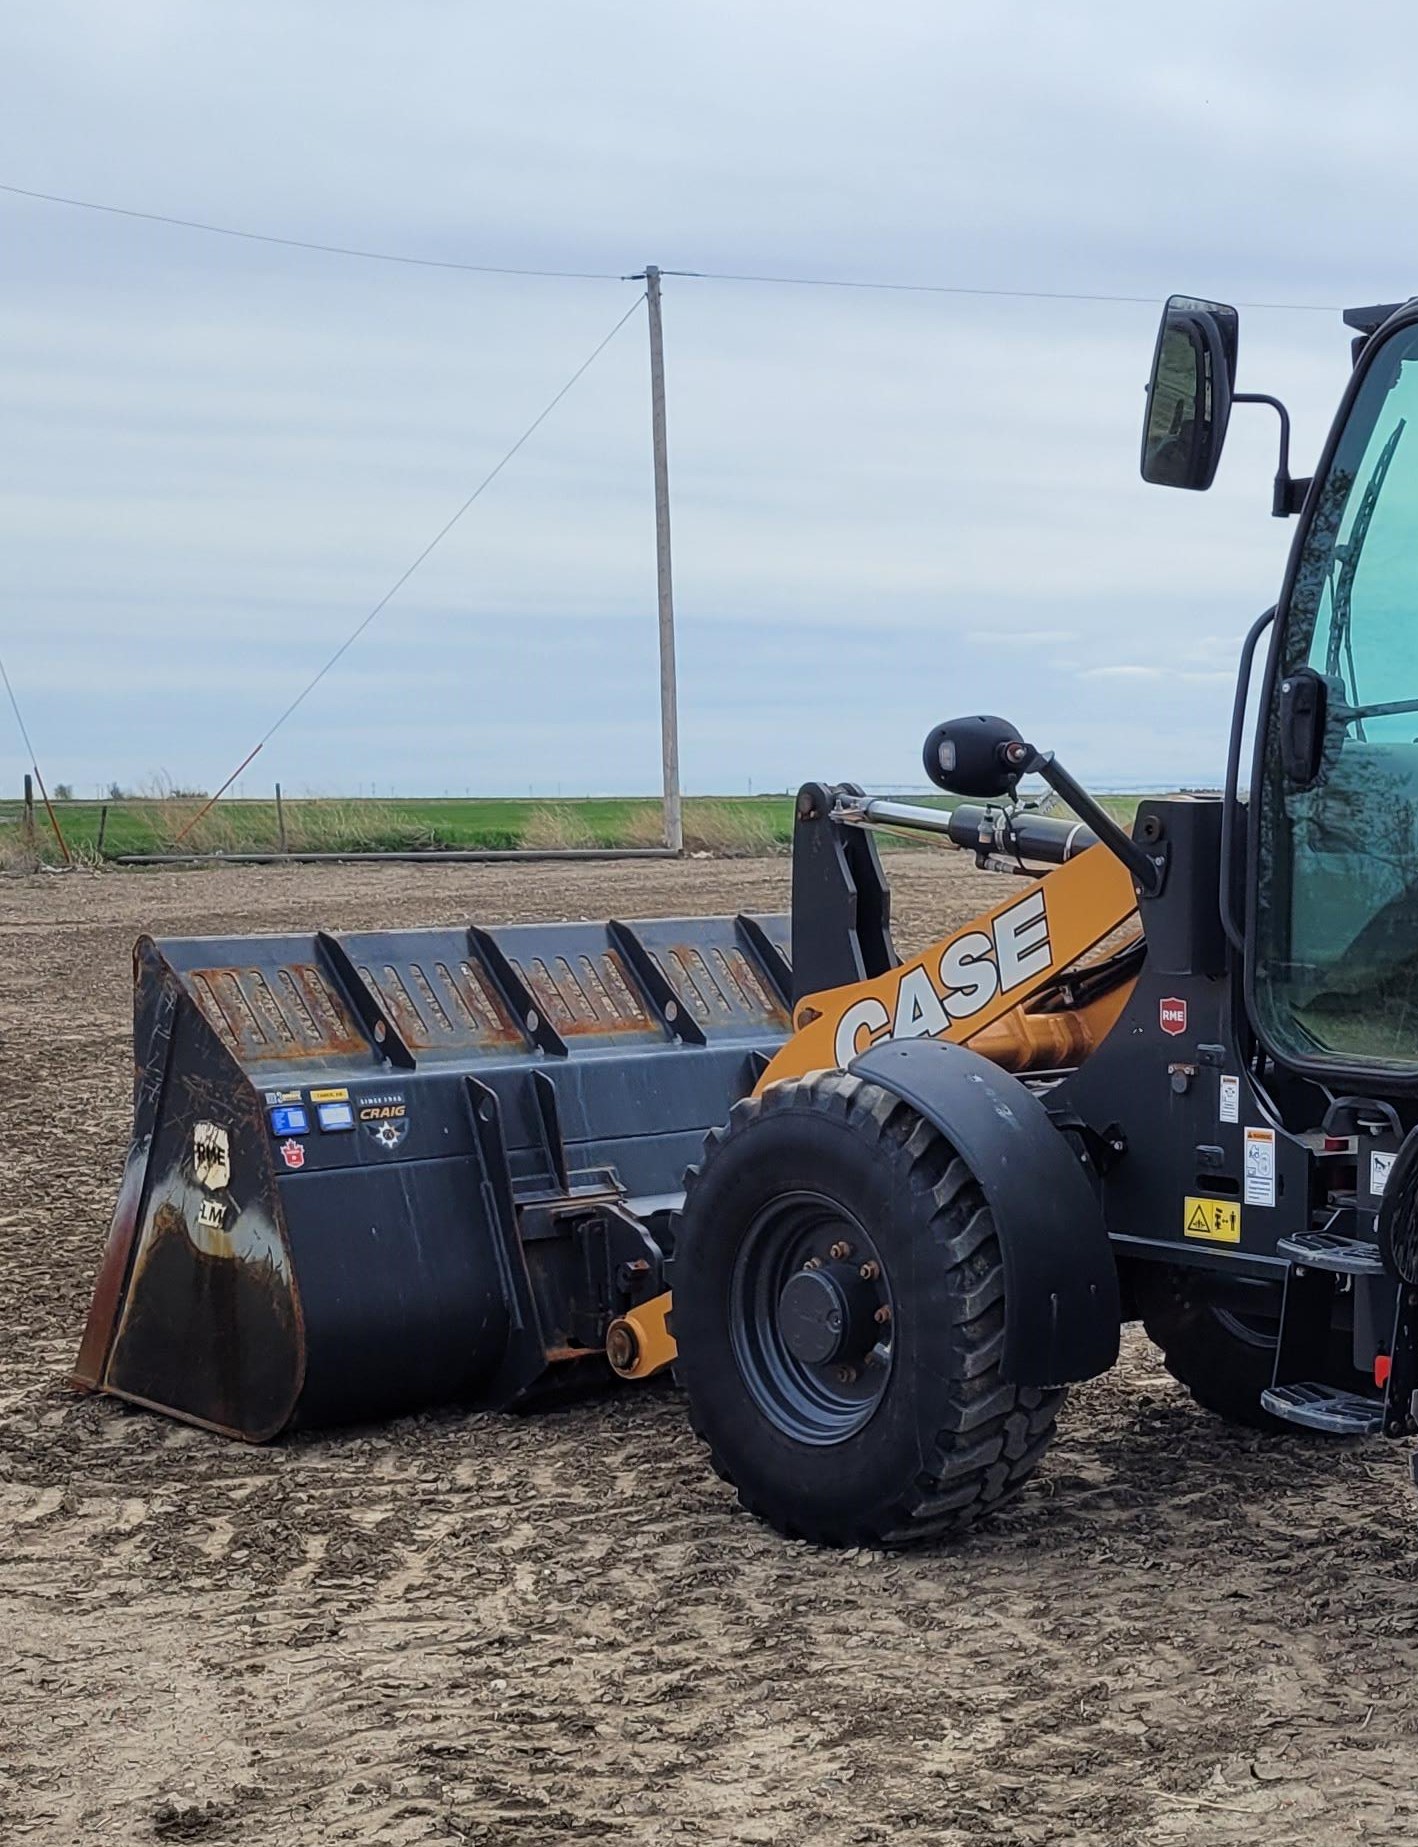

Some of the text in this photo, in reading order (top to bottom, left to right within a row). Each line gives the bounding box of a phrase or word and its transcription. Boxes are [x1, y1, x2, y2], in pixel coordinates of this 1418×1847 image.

[834, 887, 1053, 1068] CASE
[1162, 1010, 1184, 1022] RME
[360, 1105, 406, 1120] CRAIG
[197, 1142, 226, 1167] RME
[200, 1203, 223, 1224] LM
